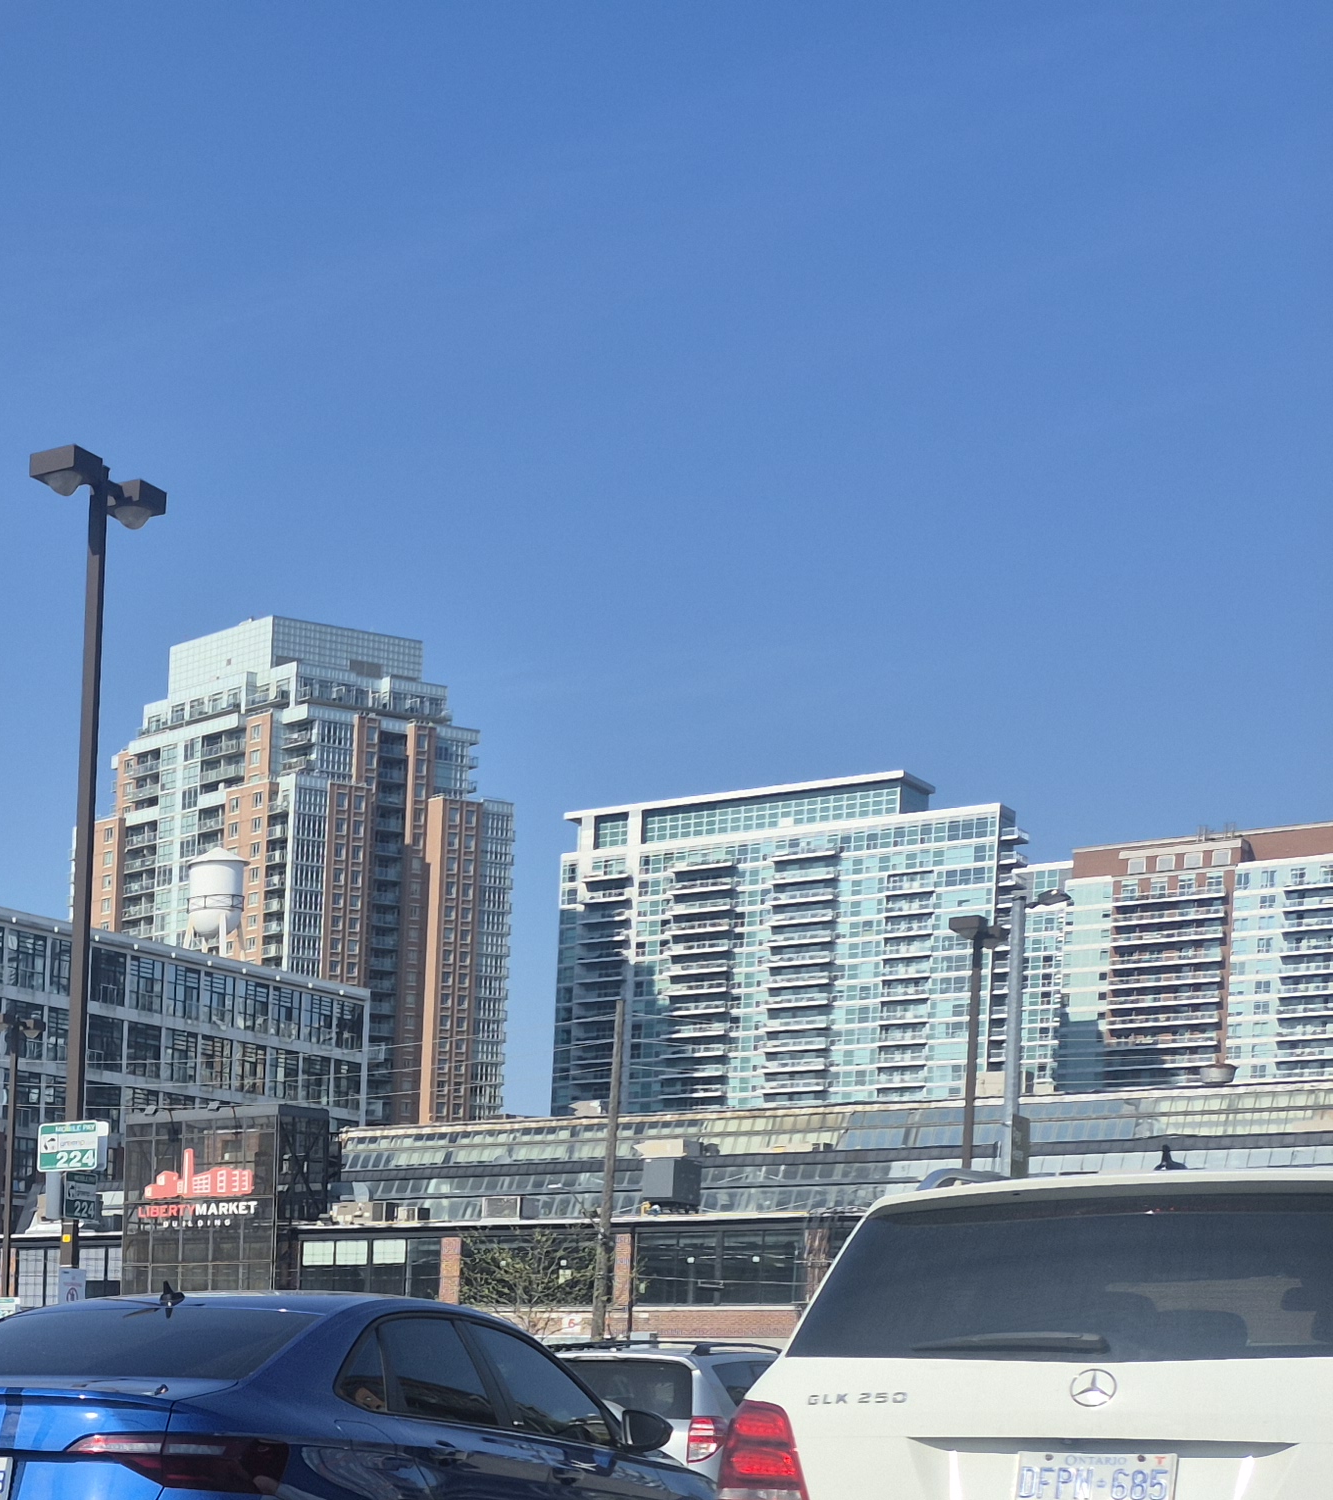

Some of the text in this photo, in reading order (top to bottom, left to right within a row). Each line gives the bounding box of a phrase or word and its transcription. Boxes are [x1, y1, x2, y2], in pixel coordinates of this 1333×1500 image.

[56, 1149, 95, 1169] 224
[74, 1200, 95, 1218] 224
[162, 1219, 231, 1228] BUILDING
[807, 1391, 908, 1406] GLK 250
[1065, 1455, 1127, 1466] ONTARIO
